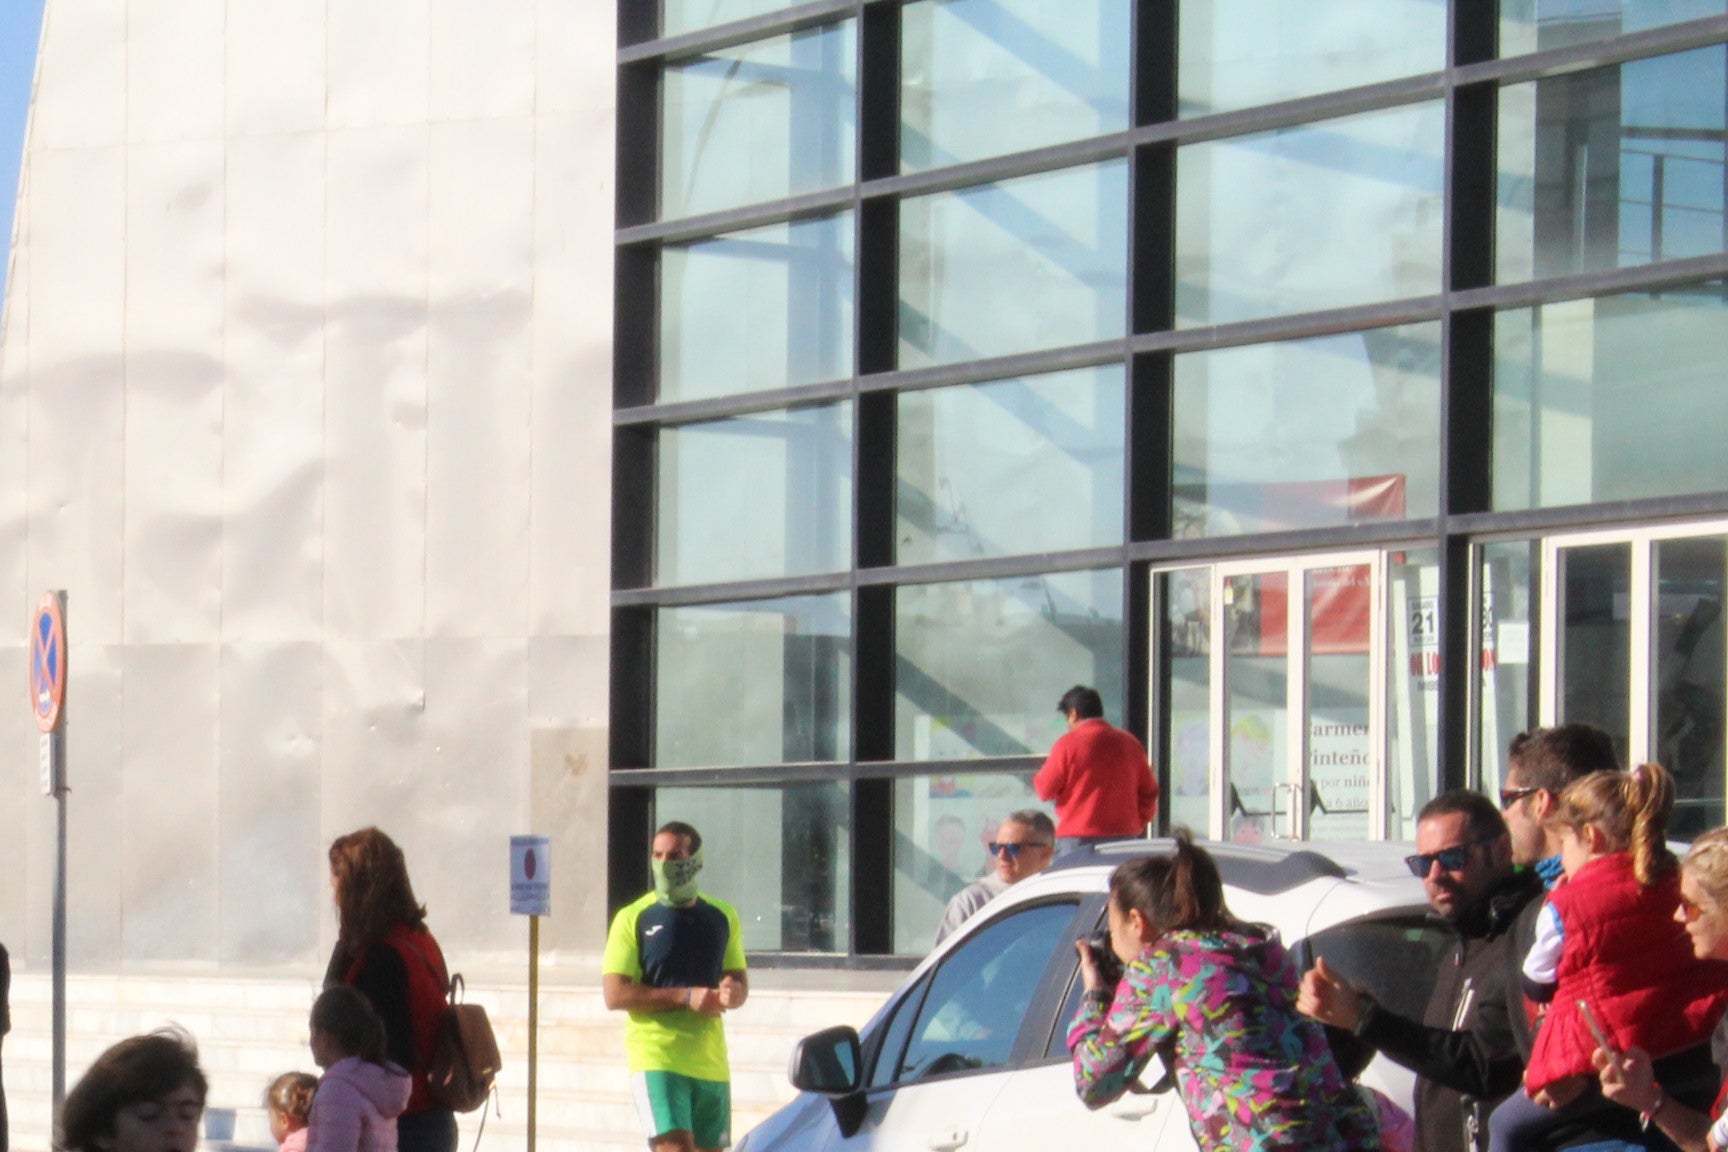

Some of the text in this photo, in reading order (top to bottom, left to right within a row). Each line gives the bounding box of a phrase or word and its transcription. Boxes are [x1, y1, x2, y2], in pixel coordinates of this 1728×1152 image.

[1411, 611, 1434, 635] 21
[1310, 723, 1369, 737] arme
[1311, 747, 1369, 766] inteño
